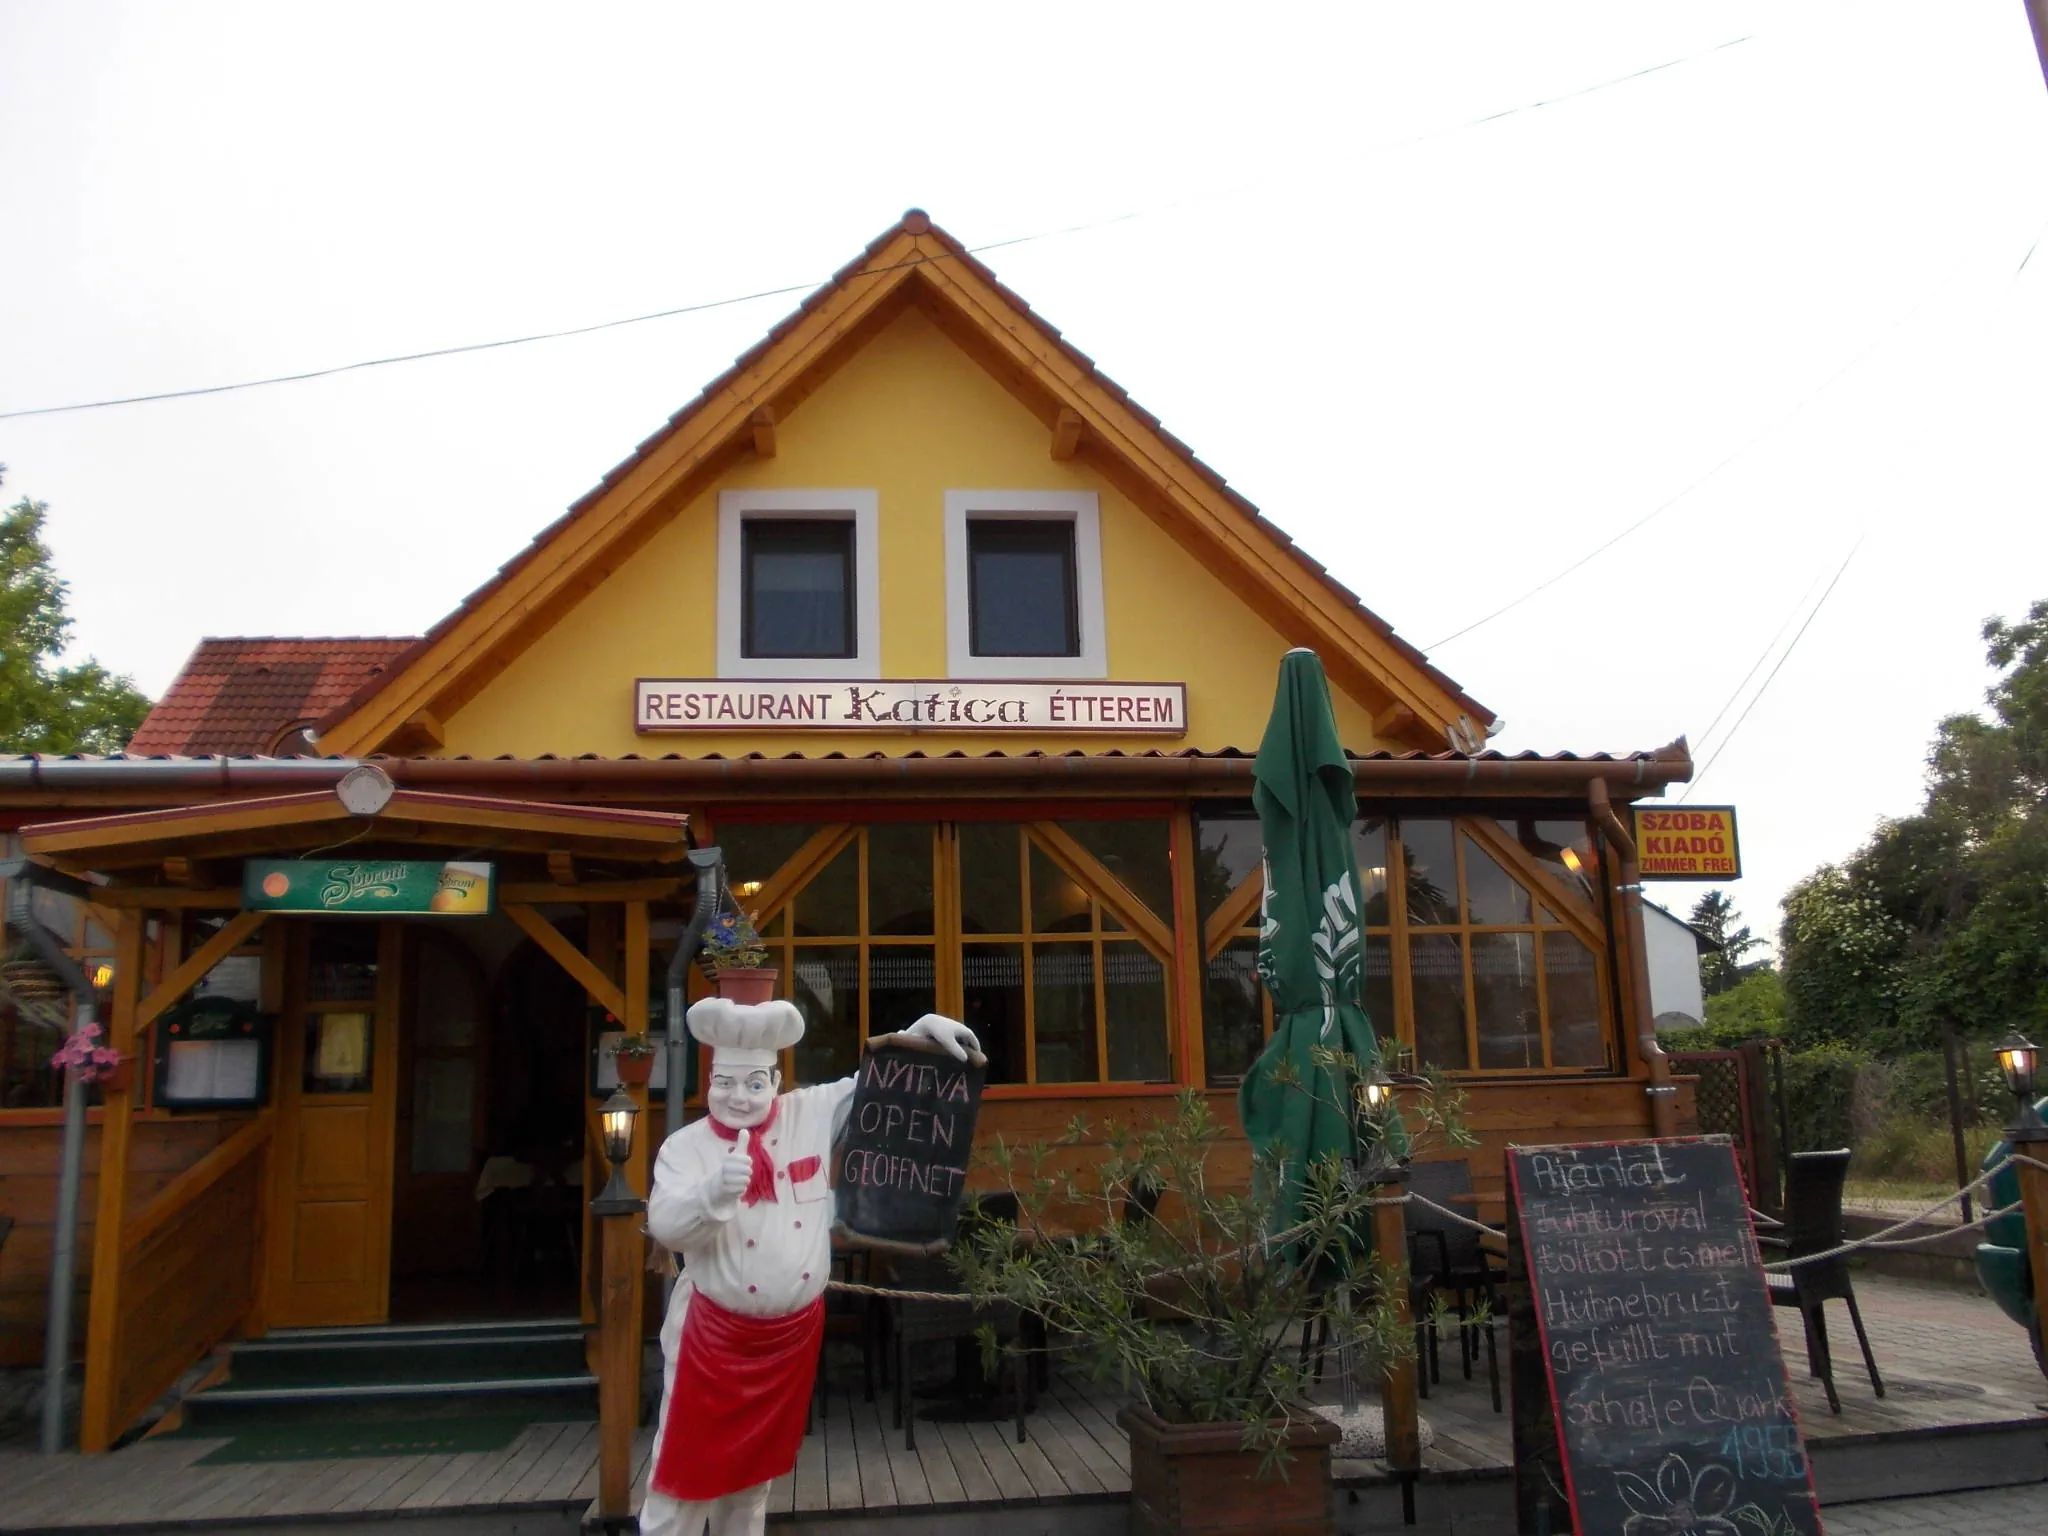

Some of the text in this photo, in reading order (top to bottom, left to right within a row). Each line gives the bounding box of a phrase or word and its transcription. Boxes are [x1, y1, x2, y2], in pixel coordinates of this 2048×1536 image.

[645, 686, 1174, 723] RESTAURANT Katica ÉTTEREM
[1641, 812, 1725, 832] SZOBA
[1646, 831, 1725, 855] KIADÓ
[1641, 857, 1734, 872] ZIMMER FREI
[320, 863, 408, 908] Soproni
[859, 1101, 955, 1148] OPEN
[844, 1143, 966, 1198] GEÖFFNET
[1551, 1317, 1741, 1374] gefüllt mit
